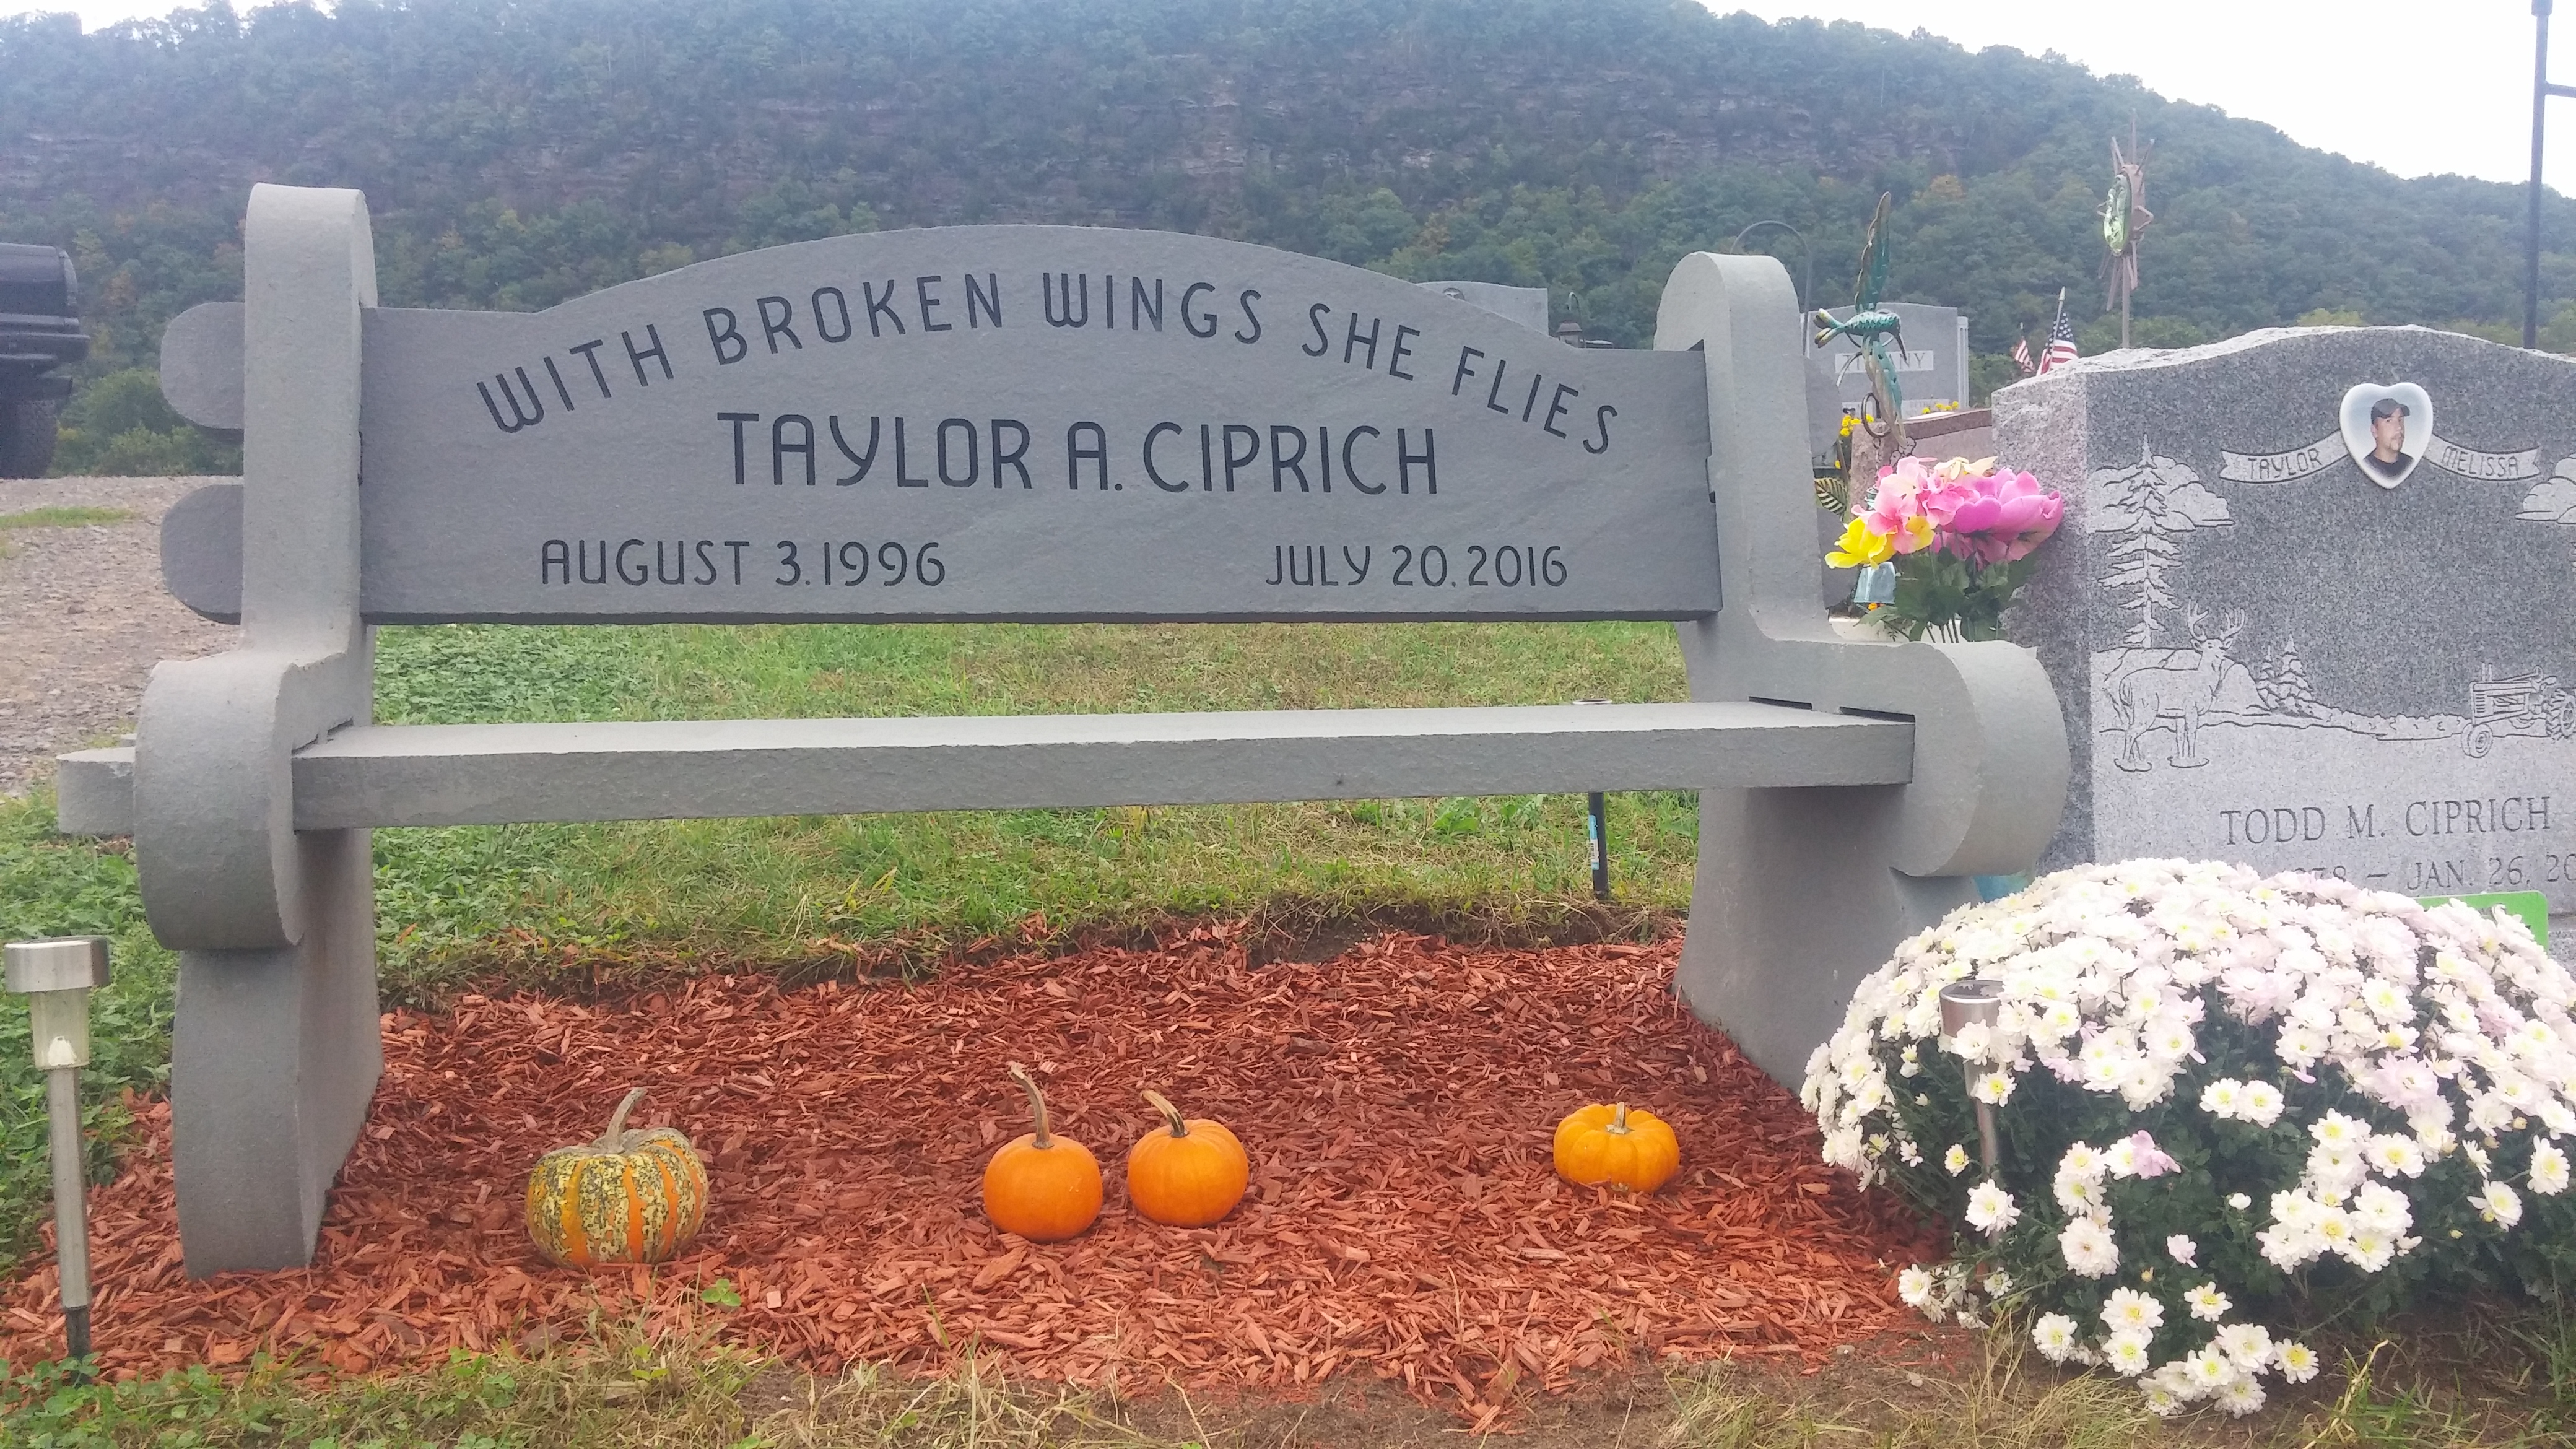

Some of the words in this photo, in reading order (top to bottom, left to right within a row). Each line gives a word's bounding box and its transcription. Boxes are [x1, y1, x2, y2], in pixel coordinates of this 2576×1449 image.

[477, 324, 675, 434] WITH
[703, 272, 1003, 366] BROKEN
[1043, 272, 1262, 344] WINGS
[1302, 303, 1421, 380] SHE
[1452, 346, 1617, 454] FLIES
[717, 413, 1032, 489] TAYLOR
[1067, 422, 1123, 490] A.
[1143, 422, 1438, 495] CIPRICH
[2247, 447, 2323, 480] TAYLOR
[2442, 446, 2520, 478] MELISSA
[542, 539, 749, 586] AUGUST
[775, 541, 946, 586] 3.1996
[1265, 545, 1371, 586] JULY
[1391, 545, 1569, 586] 20.2016
[2220, 807, 2326, 845] TODD
[2348, 804, 2387, 839] M.
[2406, 796, 2551, 836] CIPRICH
[2407, 859, 2474, 890] JAN.
[2489, 856, 2530, 886] 26,
